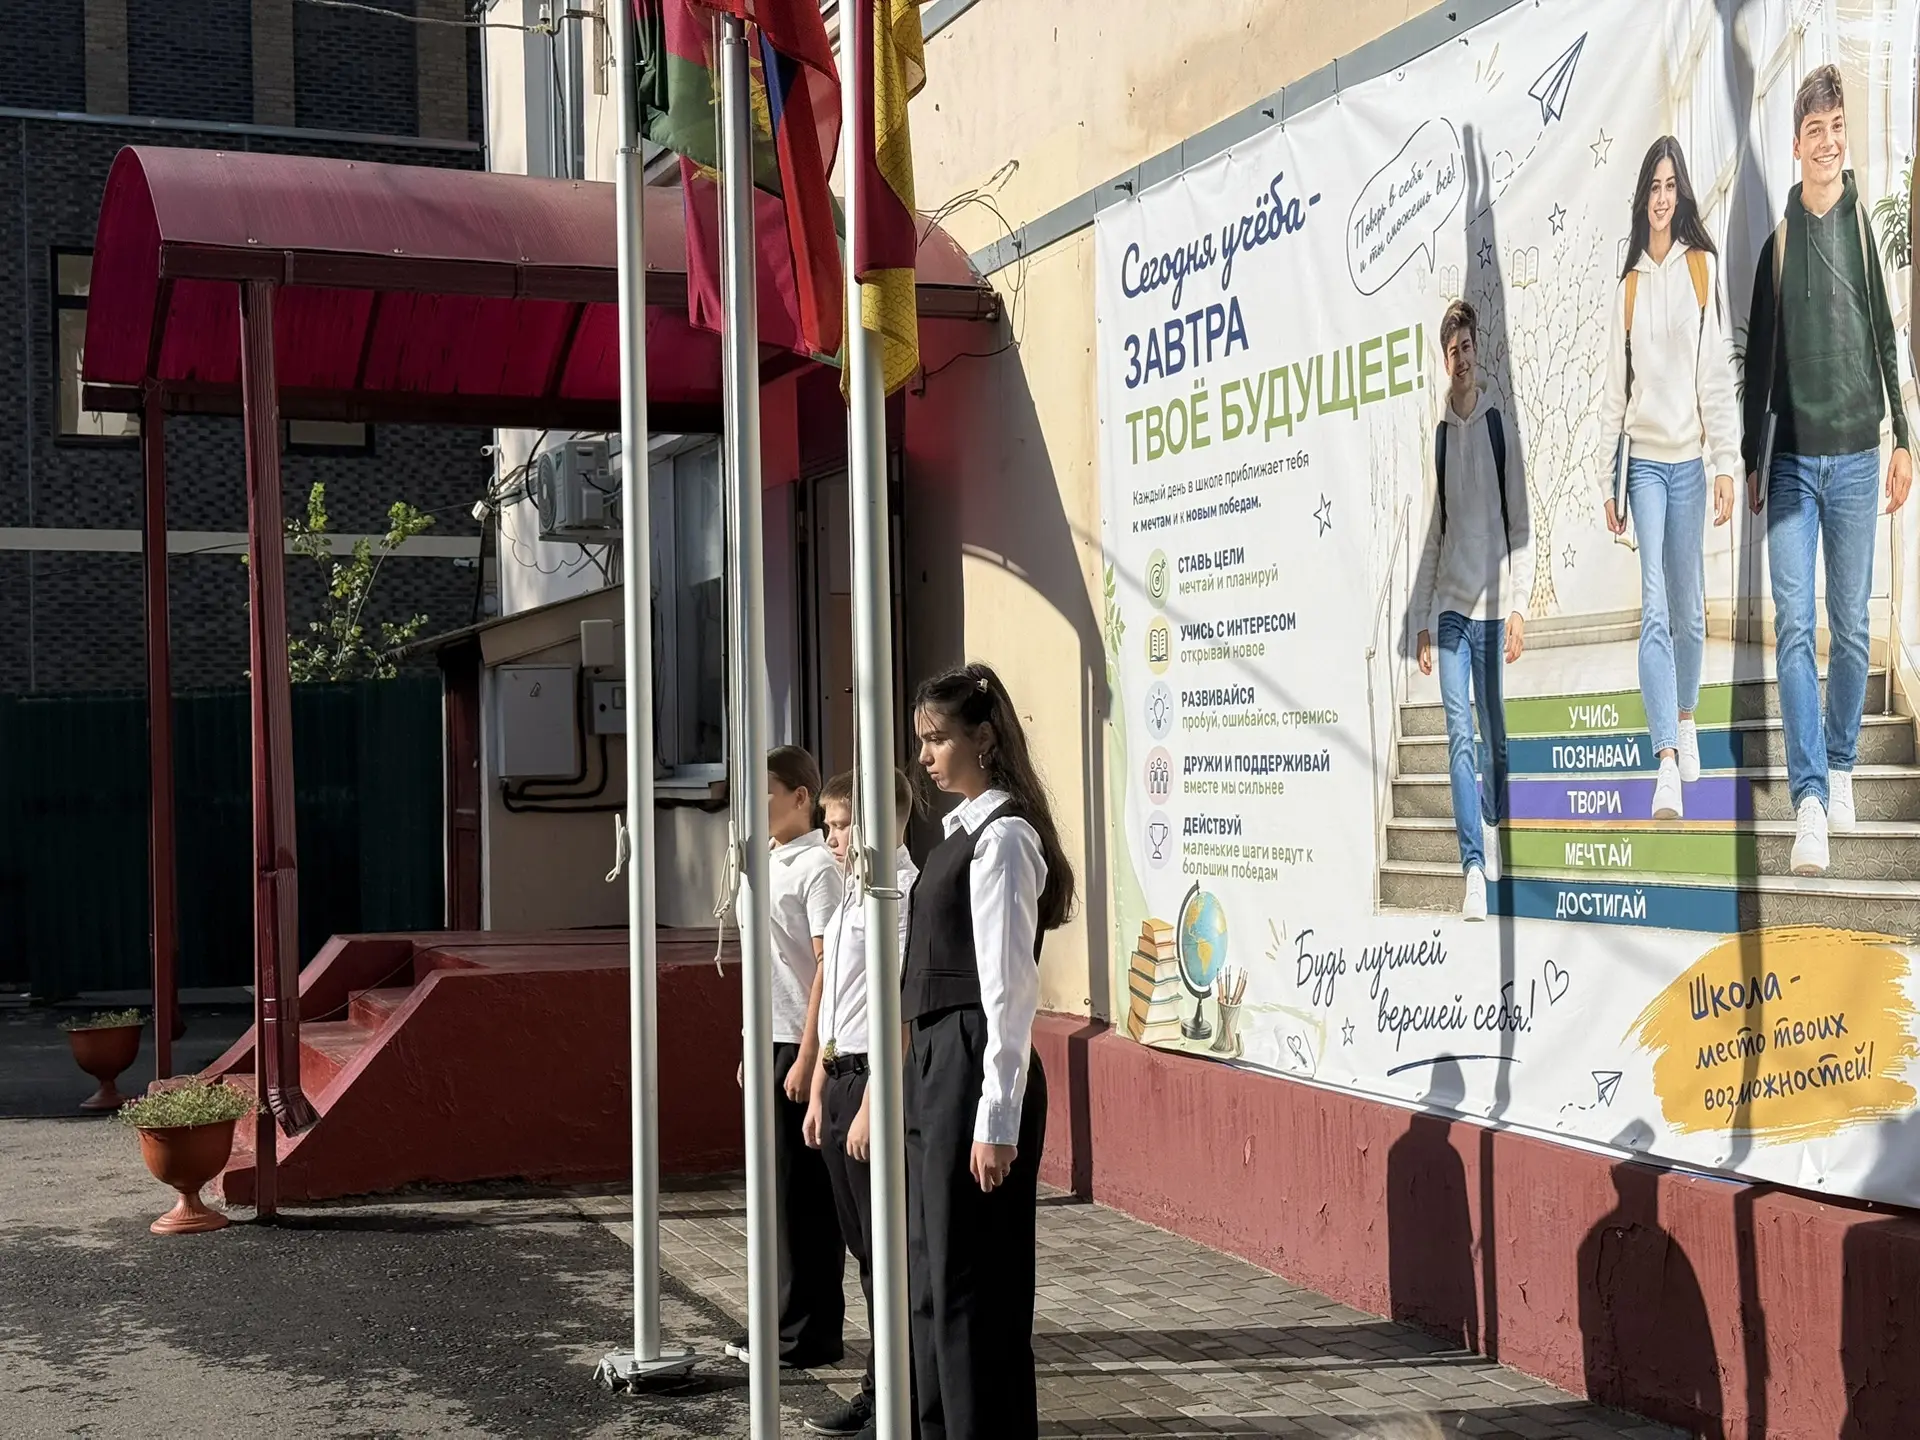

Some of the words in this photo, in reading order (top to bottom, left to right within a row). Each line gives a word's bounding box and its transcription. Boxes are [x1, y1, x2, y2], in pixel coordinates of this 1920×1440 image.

[1354, 207, 1387, 249] Поверь
[1388, 183, 1397, 207] в
[1360, 260, 1367, 273] и
[1369, 241, 1385, 265] ты
[1387, 191, 1432, 243] сможешь
[1435, 152, 1456, 195] всё!
[1121, 230, 1218, 311] Сегодня
[1123, 295, 1250, 390] ЗАВТРА
[1125, 376, 1212, 466] ТВОЁ
[1219, 322, 1426, 444] БУДУЩЕЕ!
[1132, 484, 1166, 506] Каждый
[1167, 478, 1187, 500] день
[1188, 479, 1194, 493] в
[1195, 471, 1224, 493] школе
[1225, 457, 1284, 488] приближает
[1286, 450, 1310, 472] тебя
[1132, 519, 1139, 534] к
[1141, 511, 1172, 532] мечтам
[1173, 512, 1179, 525] и
[1180, 511, 1185, 524] к
[1186, 500, 1217, 523] новым
[1219, 493, 1262, 518] победам.
[1177, 551, 1213, 574] СТАВЬ
[1214, 546, 1245, 571] ЦЕЛИ
[1178, 570, 1215, 596] мечтай
[1217, 572, 1224, 590] и
[1226, 562, 1279, 588] планируй
[1180, 621, 1215, 642] УЧИСЬ
[1216, 619, 1225, 638] С
[1227, 611, 1297, 638] ИНТЕРЕСОМ
[1180, 643, 1231, 665] открывай
[1232, 642, 1265, 658] новое
[1181, 683, 1256, 708] РАЗВИВАЙСЯ
[1181, 711, 1221, 733] пробуй,
[1222, 707, 1280, 728] ошибайся,
[1281, 708, 1338, 728] стремись
[1568, 703, 1620, 730] УЧИСЬ
[1183, 755, 1223, 775] ДРУЖИ
[1225, 755, 1232, 773] И
[1234, 749, 1331, 775] ПОДДЕРЖИВАЙ
[1552, 737, 1642, 769] ПОЗНАВАЙ
[1183, 781, 1219, 794] вместе
[1221, 781, 1237, 795] мы
[1239, 780, 1285, 796] сильнее
[1567, 790, 1623, 815] ТВОРИ
[1183, 814, 1242, 836] ДЕЙСТВУЙ
[1183, 840, 1240, 858] маленькие
[1242, 845, 1270, 860] шаги
[1272, 846, 1304, 866] ведут
[1306, 848, 1314, 864] к
[1565, 837, 1633, 868] МЕЧТАЙ
[1182, 857, 1229, 878] большим
[1232, 862, 1279, 884] победам
[1555, 889, 1647, 920] ДОСТИГАЙ
[1295, 929, 1347, 1008] Будь
[1355, 929, 1448, 1000] лучшей
[1377, 987, 1467, 1052] версией
[1473, 978, 1536, 1033] себя!
[1696, 1026, 1767, 1070] место
[1774, 1012, 1849, 1050] твоих
[1703, 1040, 1875, 1124] возможностей!
